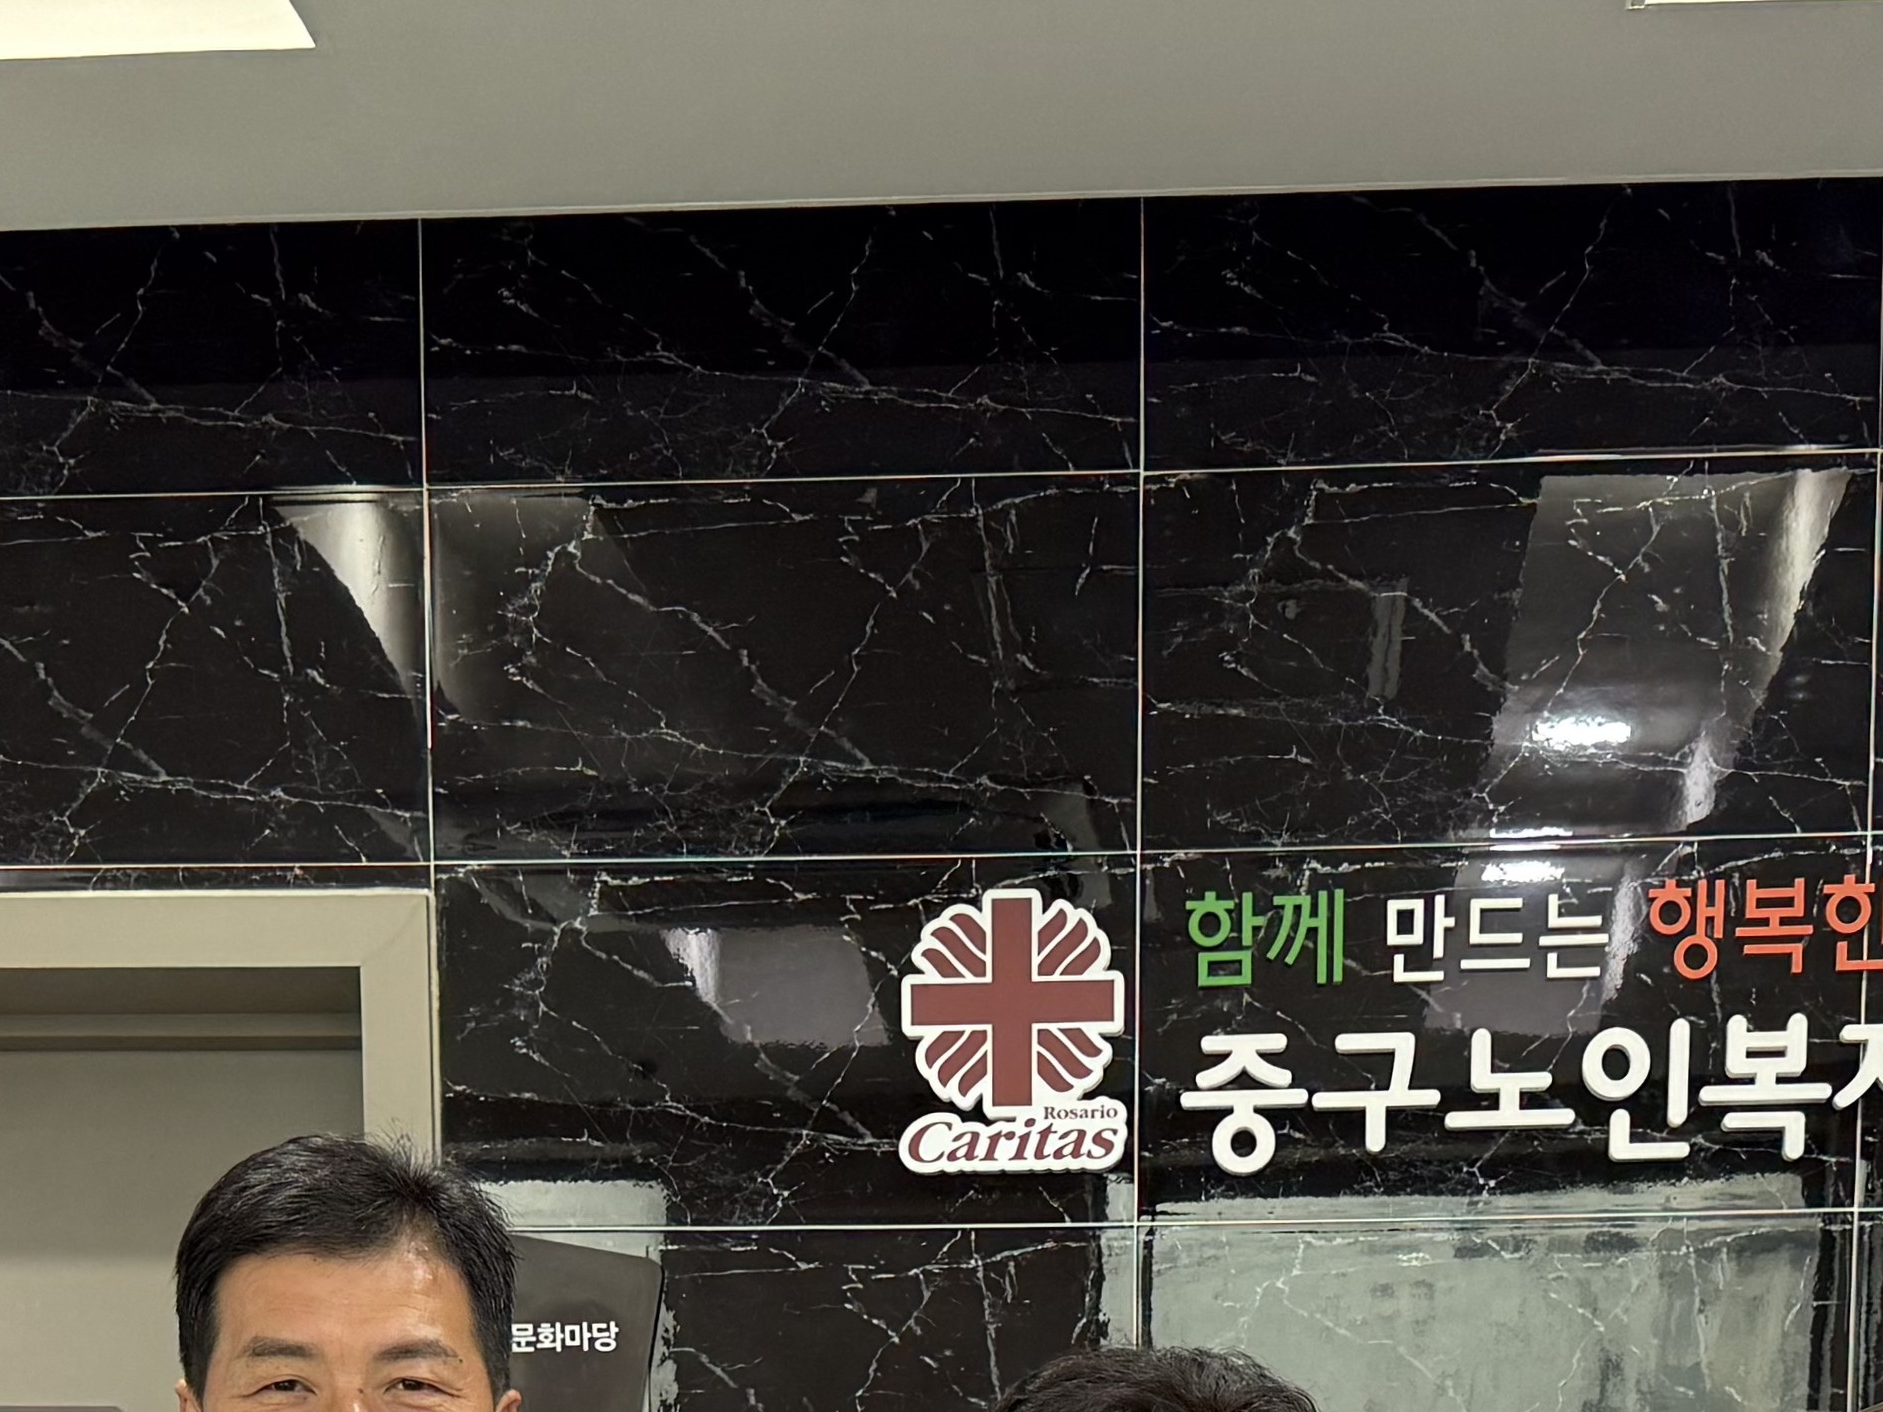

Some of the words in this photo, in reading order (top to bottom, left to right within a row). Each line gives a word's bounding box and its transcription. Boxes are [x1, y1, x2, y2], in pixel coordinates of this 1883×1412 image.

[1186, 891, 1346, 985] 함께
[1386, 893, 1608, 982] 만드는
[1044, 1105, 1119, 1120] Rosario
[909, 1119, 1116, 1164] Caritas
[511, 1321, 619, 1352] 문화마당
